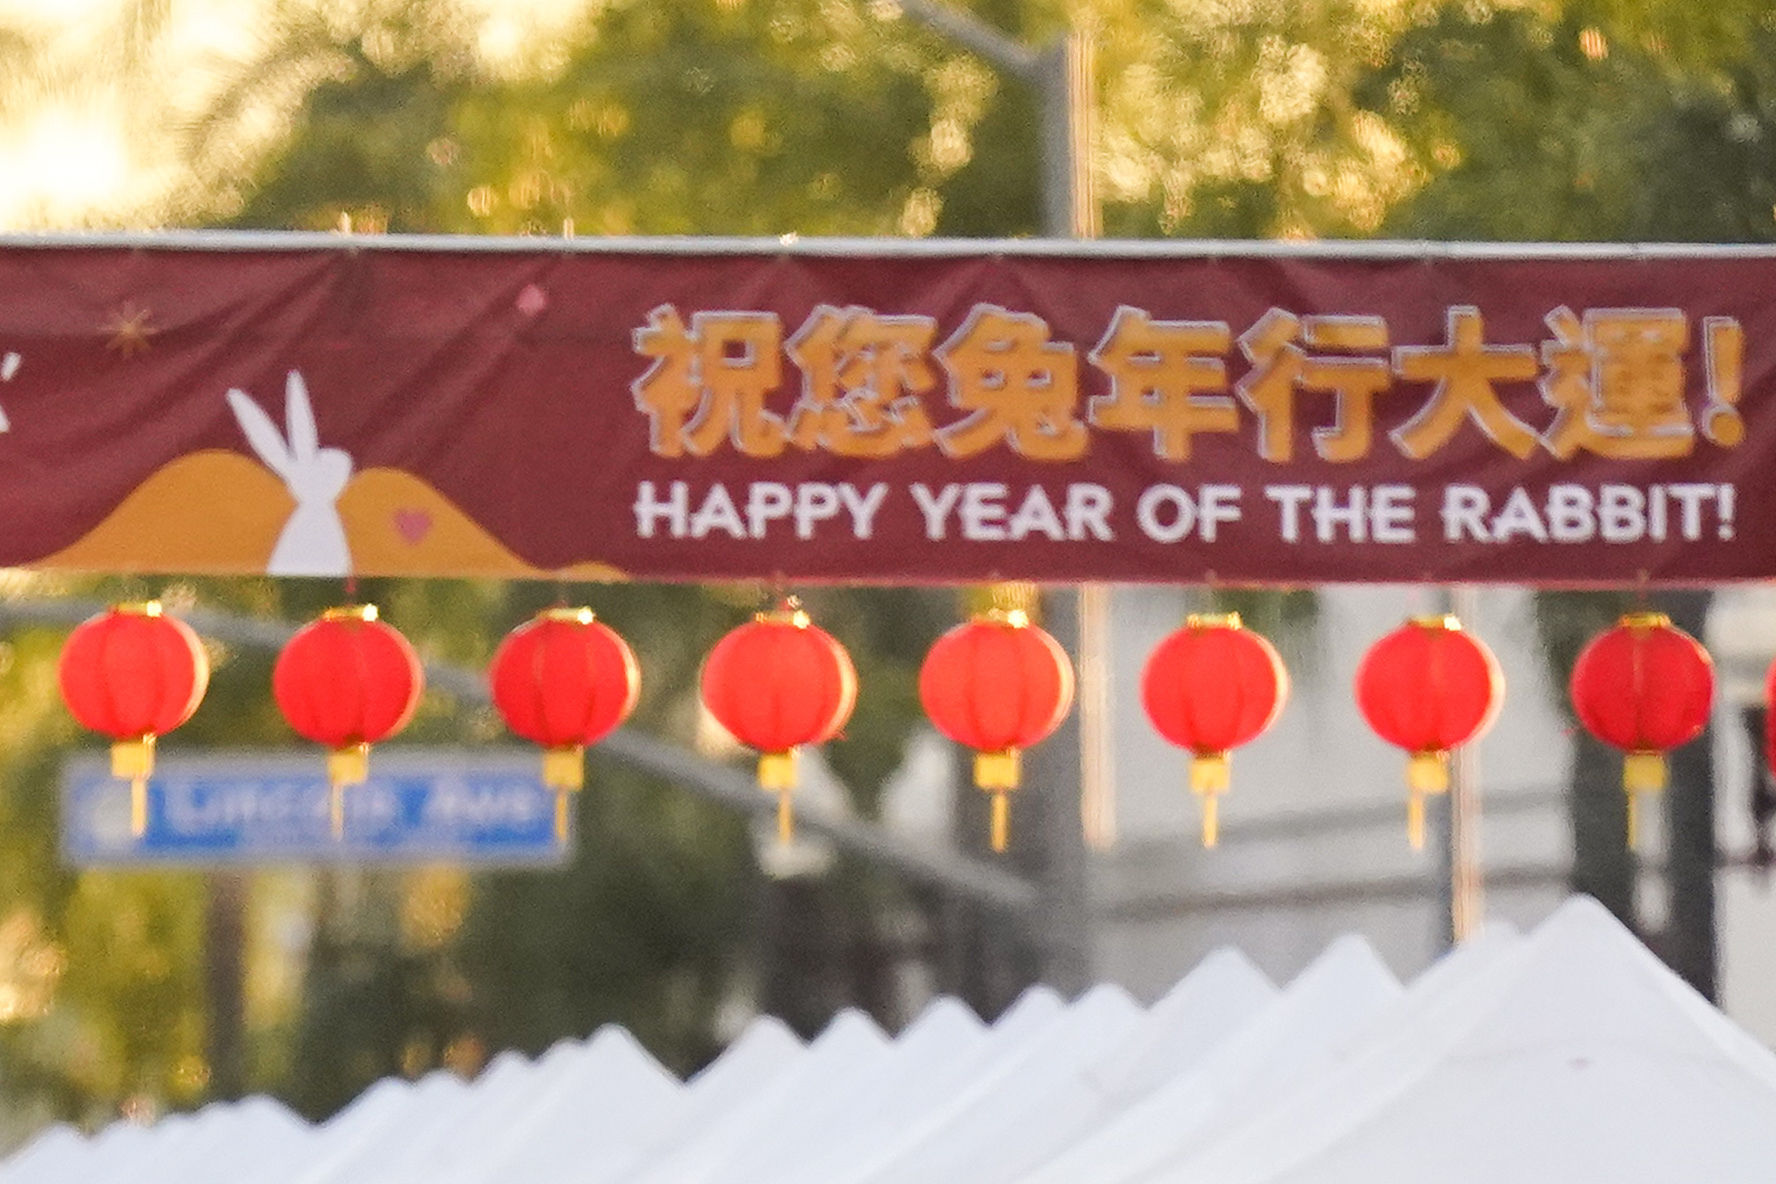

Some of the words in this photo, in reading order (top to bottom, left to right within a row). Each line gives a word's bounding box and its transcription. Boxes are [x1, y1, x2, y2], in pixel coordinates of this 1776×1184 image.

[632, 302, 1746, 463] 祝您兔年行大運!
[634, 480, 888, 540] HAPPY
[911, 481, 1114, 542] YEAR
[1136, 483, 1241, 542] OF
[1267, 484, 1414, 543] THE
[1442, 482, 1735, 543] RABBIT!
